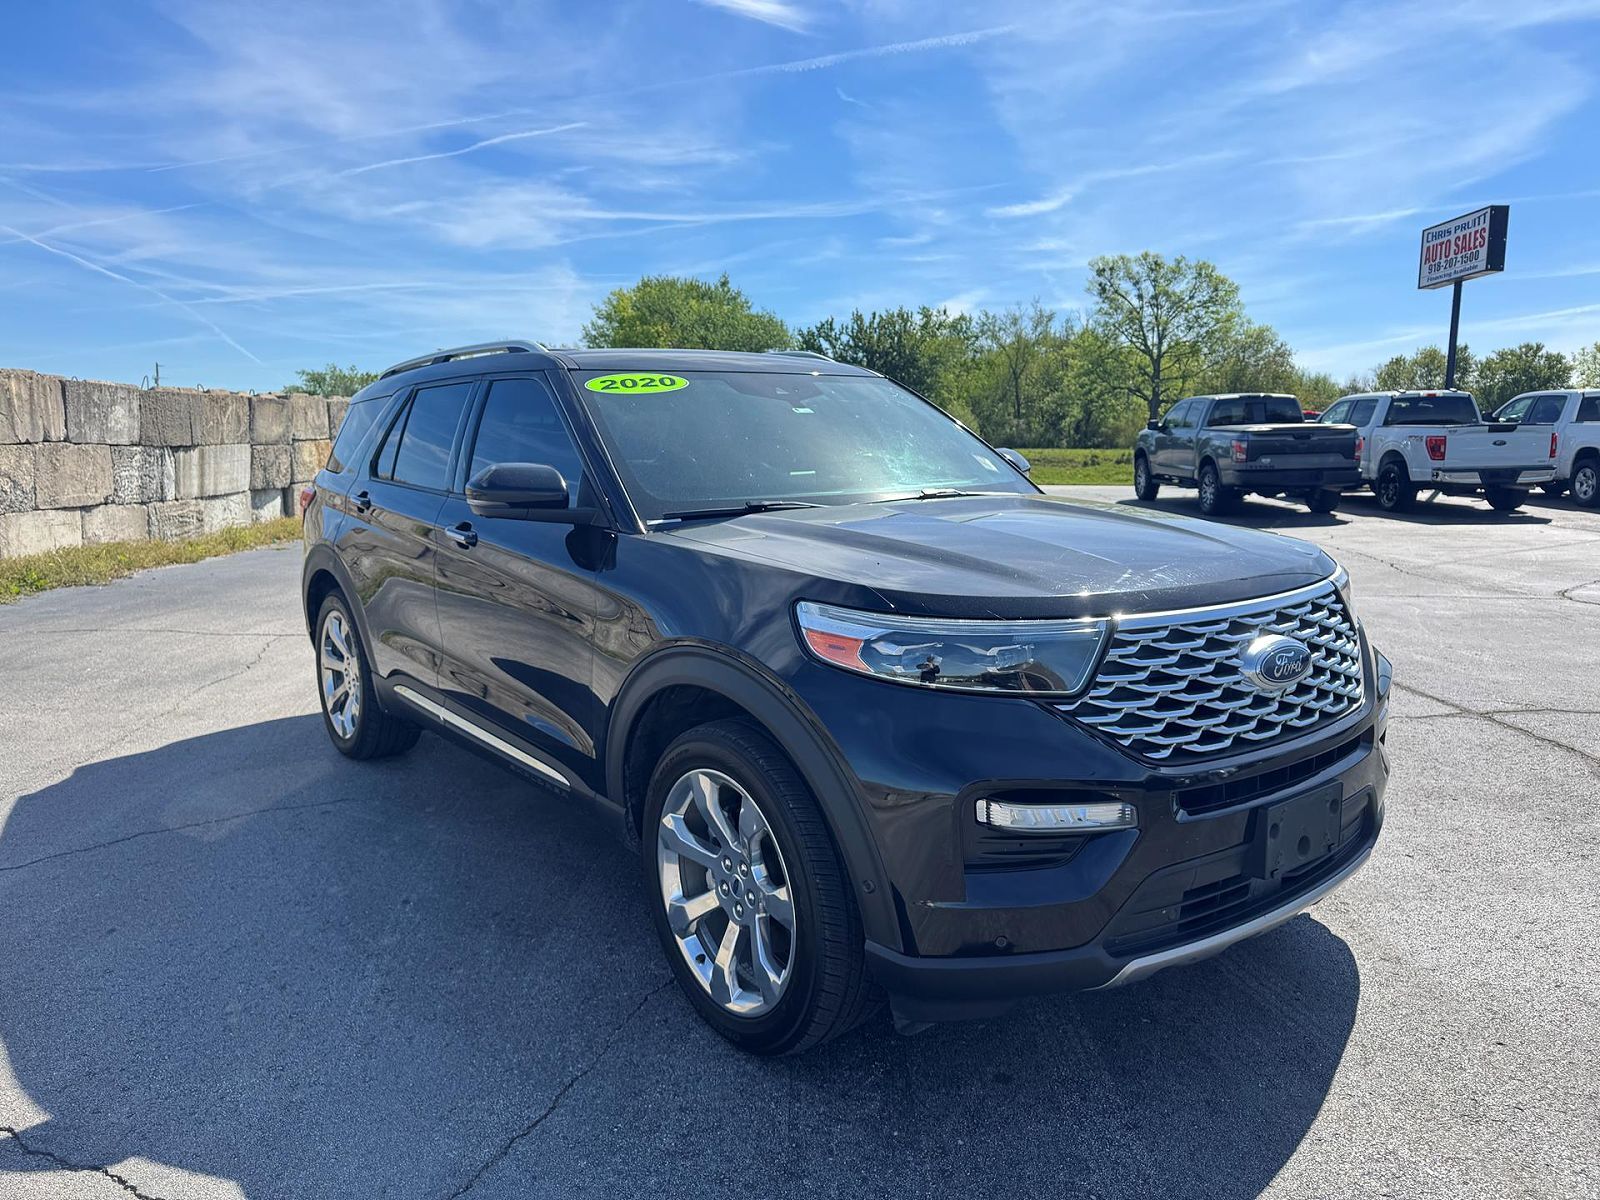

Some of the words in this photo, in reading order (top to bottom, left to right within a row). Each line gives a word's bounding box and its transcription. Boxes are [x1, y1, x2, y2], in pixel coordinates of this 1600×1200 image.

[1426, 227, 1452, 243] CHRIS
[1454, 211, 1488, 234] PRUITT
[1424, 238, 1451, 265] AUTO
[1453, 227, 1486, 255] SALES
[1428, 250, 1480, 274] 918-207-1500
[600, 377, 676, 390] 2020
[1274, 651, 1303, 678] Ford
